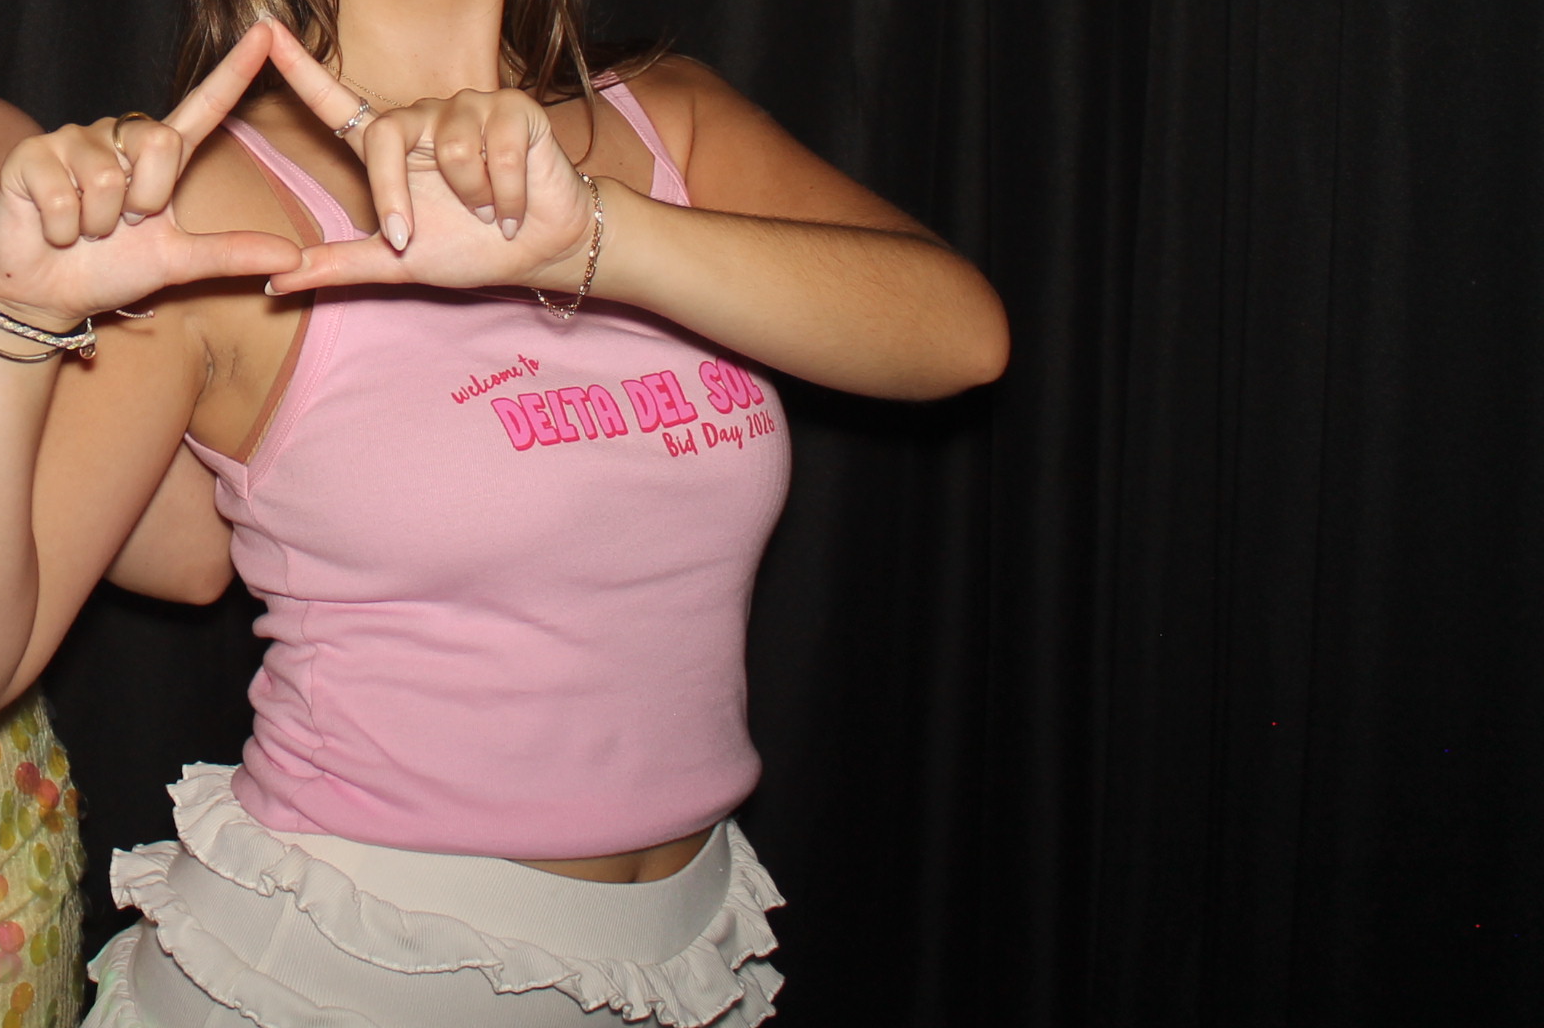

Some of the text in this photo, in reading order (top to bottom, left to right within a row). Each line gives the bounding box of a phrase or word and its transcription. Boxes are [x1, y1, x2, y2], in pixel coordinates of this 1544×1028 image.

[450, 353, 540, 405] welcome to
[491, 384, 628, 451] DELTA
[621, 370, 698, 433] DEL
[662, 409, 775, 458] Bid Day 2026
